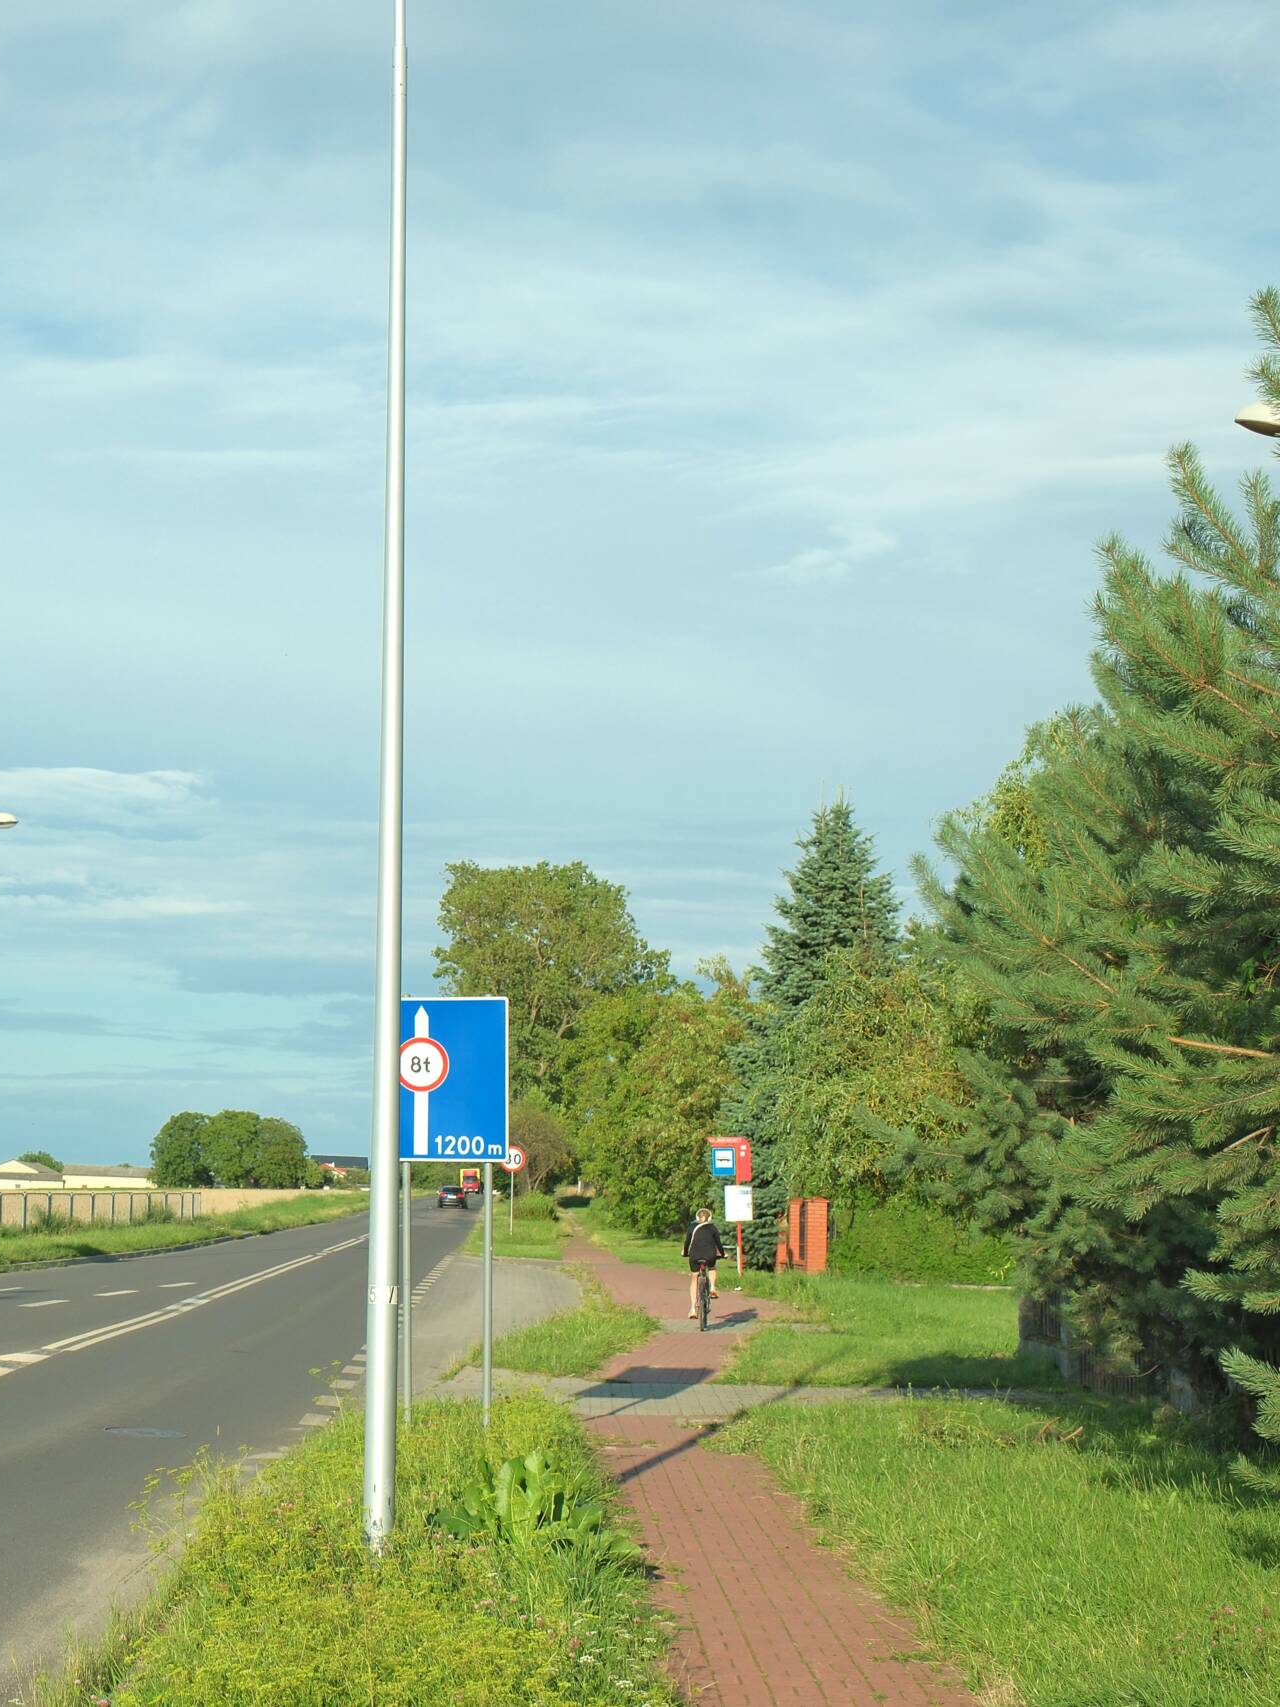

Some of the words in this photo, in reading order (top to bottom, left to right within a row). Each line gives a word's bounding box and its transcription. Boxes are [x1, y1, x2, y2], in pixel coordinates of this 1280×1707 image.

[410, 1056, 431, 1073] 8t
[435, 1135, 485, 1155] 1200
[487, 1143, 503, 1156] m
